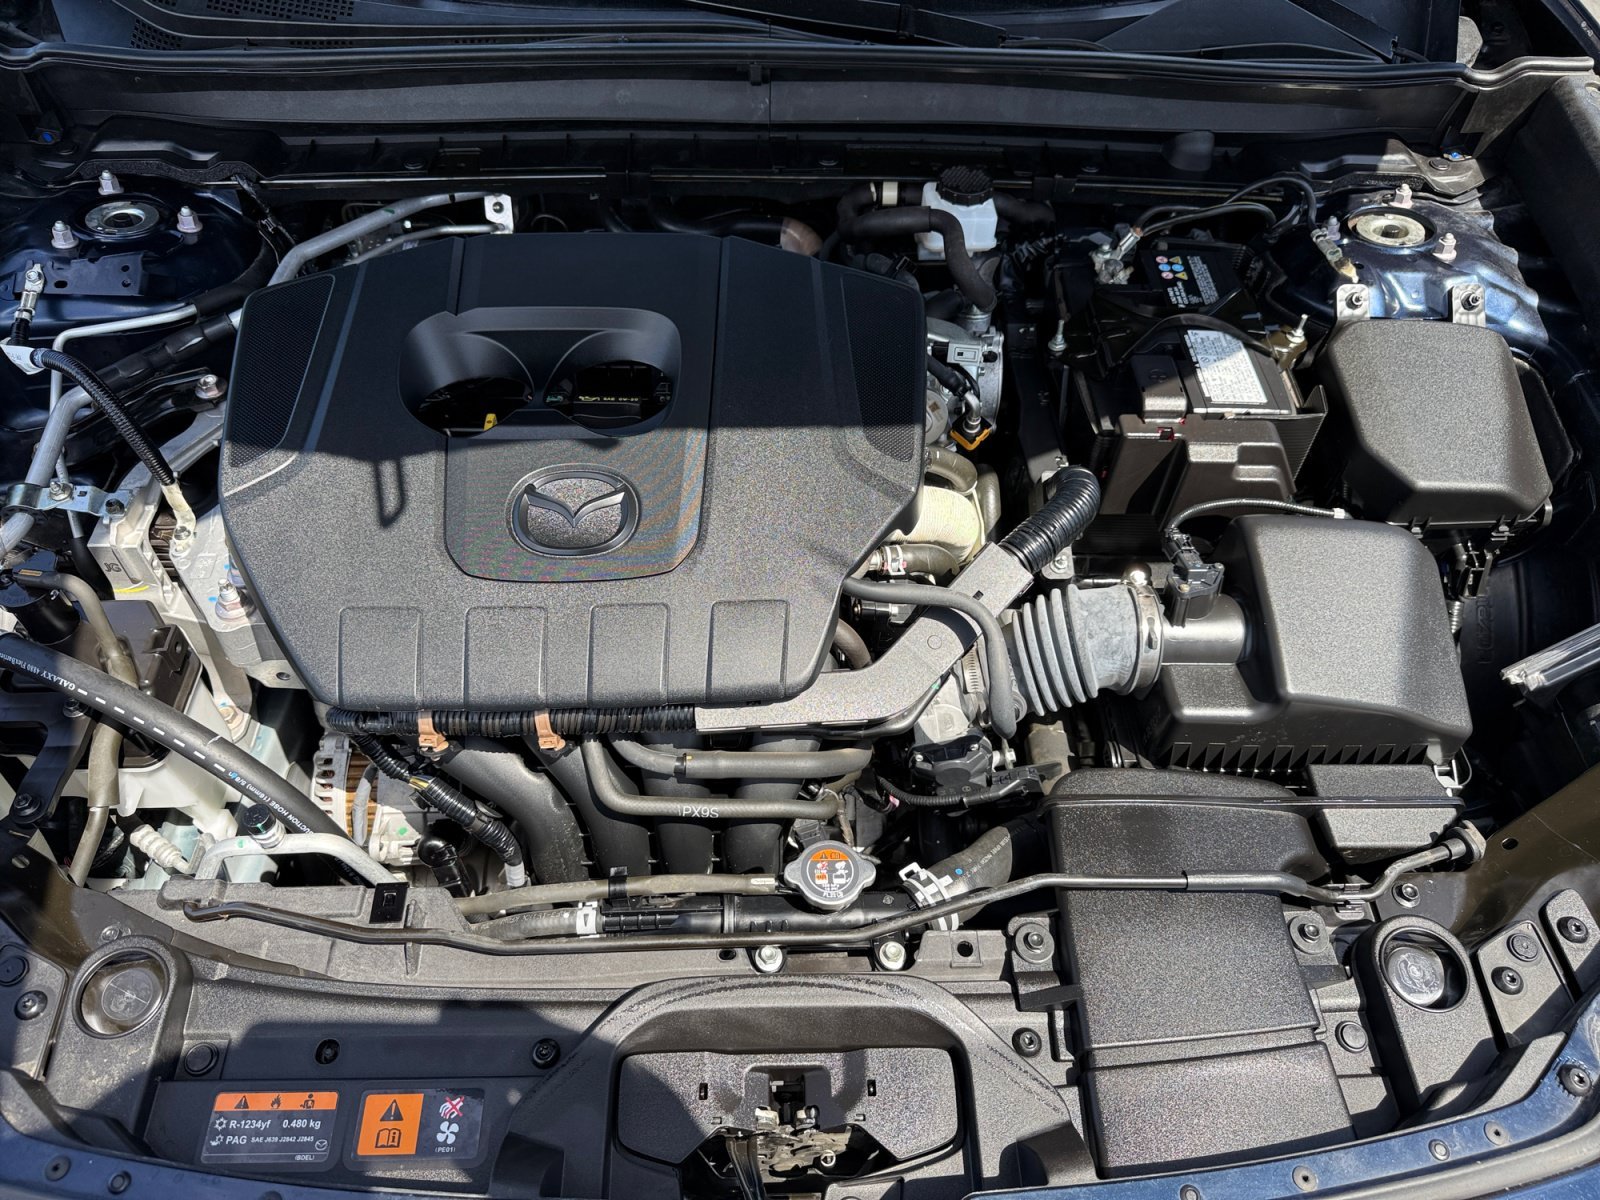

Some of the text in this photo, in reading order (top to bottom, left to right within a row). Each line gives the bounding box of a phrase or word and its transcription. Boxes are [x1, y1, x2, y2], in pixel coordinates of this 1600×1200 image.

[40, 670, 76, 691] GALAXY
[246, 783, 272, 802] (16mm)
[269, 800, 289, 816] HOSE
[229, 1118, 321, 1130] R-1234yf 0.480 kg
[225, 1136, 247, 1144] PAG
